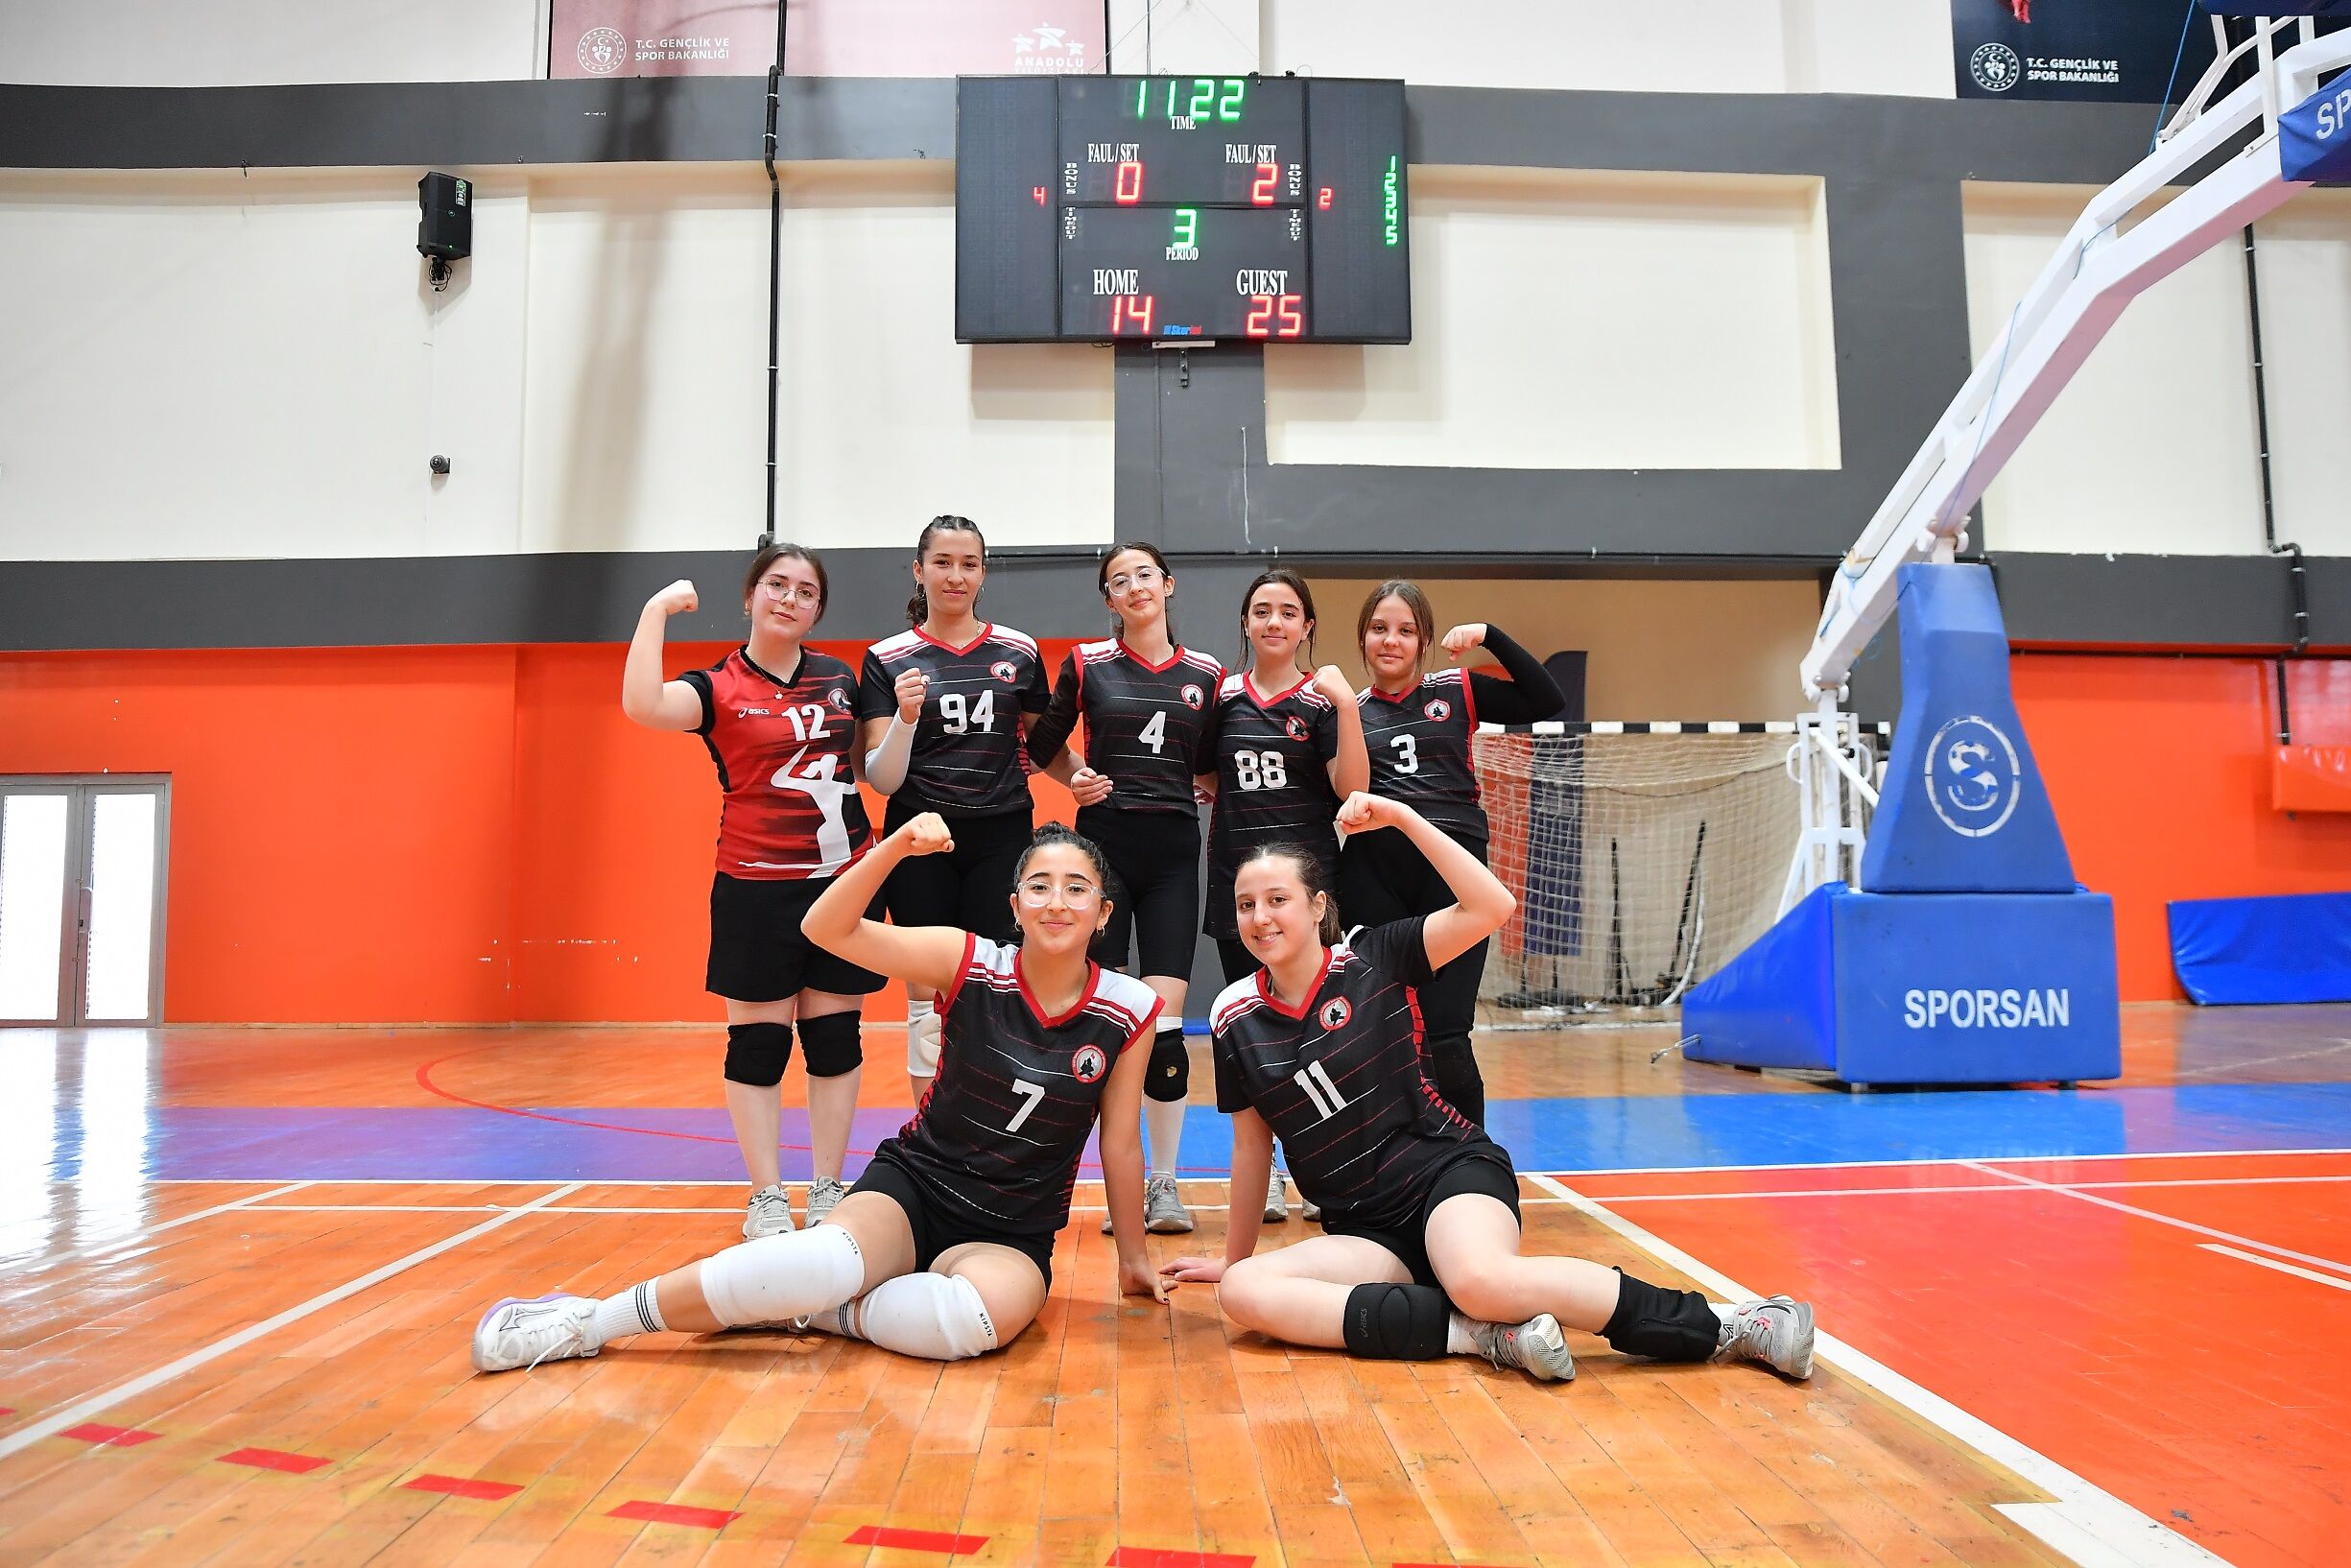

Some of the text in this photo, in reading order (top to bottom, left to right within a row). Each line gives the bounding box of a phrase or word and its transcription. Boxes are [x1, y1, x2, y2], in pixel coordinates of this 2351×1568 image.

[635, 36, 729, 48] T.C. GENÇLİK VE
[635, 49, 729, 60] SPOR BAKANLIĞI
[1014, 57, 1084, 67] ANADOLU
[2026, 58, 2119, 71] T.C. GENÇLİK VE
[2027, 70, 2120, 83] SPOR BAKANLIĞI
[1170, 116, 1197, 130] TIME
[1087, 143, 1140, 162] FAUL/SET
[1224, 143, 1277, 163] FAUL/SET
[1115, 161, 1142, 202] 0
[1252, 163, 1279, 202] 2
[1033, 186, 1046, 206] 4
[1318, 187, 1333, 207] 2
[1172, 208, 1198, 249] 3
[1166, 246, 1199, 260] PERIOD
[1093, 269, 1139, 295] HOME
[1236, 269, 1288, 296] GUEST
[1111, 296, 1153, 334] 14
[1247, 295, 1302, 335] 25
[781, 703, 831, 742] 12
[938, 689, 996, 735] 94
[1138, 711, 1167, 754] 4
[1389, 733, 1419, 774] 3
[1234, 749, 1287, 791] 88
[1904, 987, 2070, 1029] SPORSAN
[1294, 1059, 1348, 1120] 11
[1005, 1078, 1046, 1132] 7
[979, 1312, 992, 1337] KIPSTA
